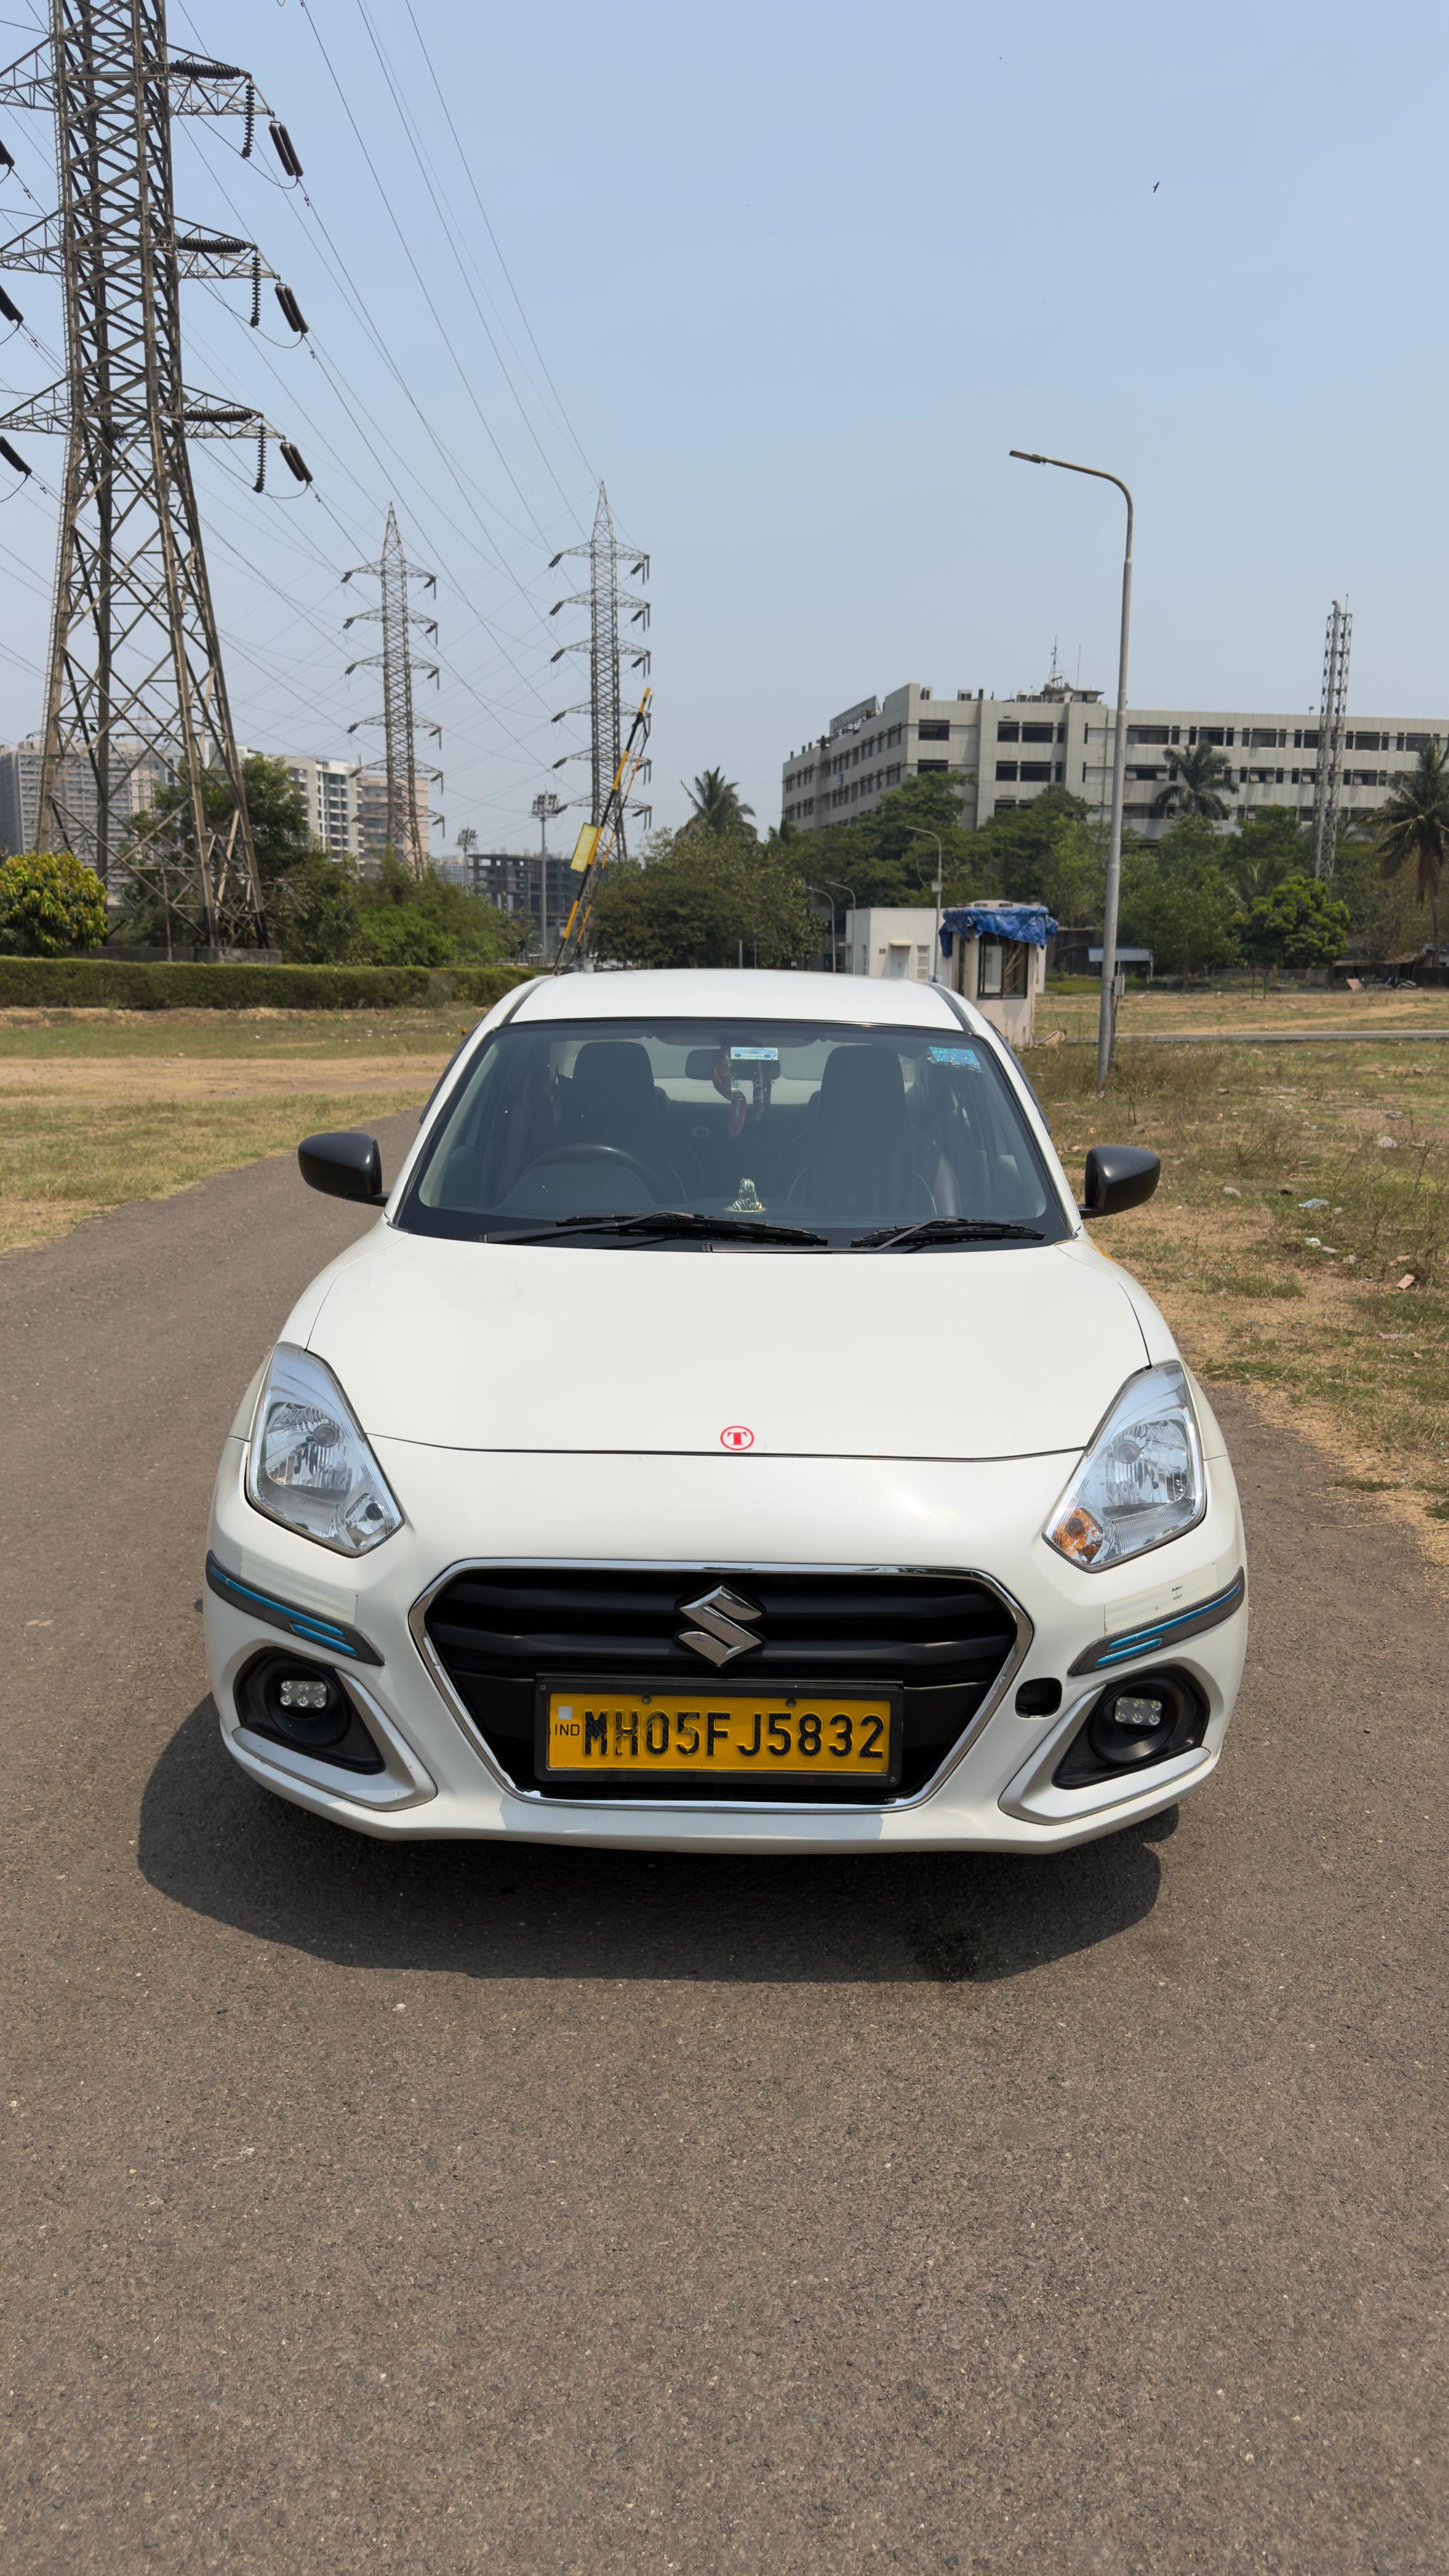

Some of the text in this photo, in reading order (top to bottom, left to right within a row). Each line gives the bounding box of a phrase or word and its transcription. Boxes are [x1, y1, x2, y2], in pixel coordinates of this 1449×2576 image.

[727, 1431, 748, 1446] T
[555, 1723, 580, 1736] IND
[584, 1709, 884, 1758] MH05FJ5832
